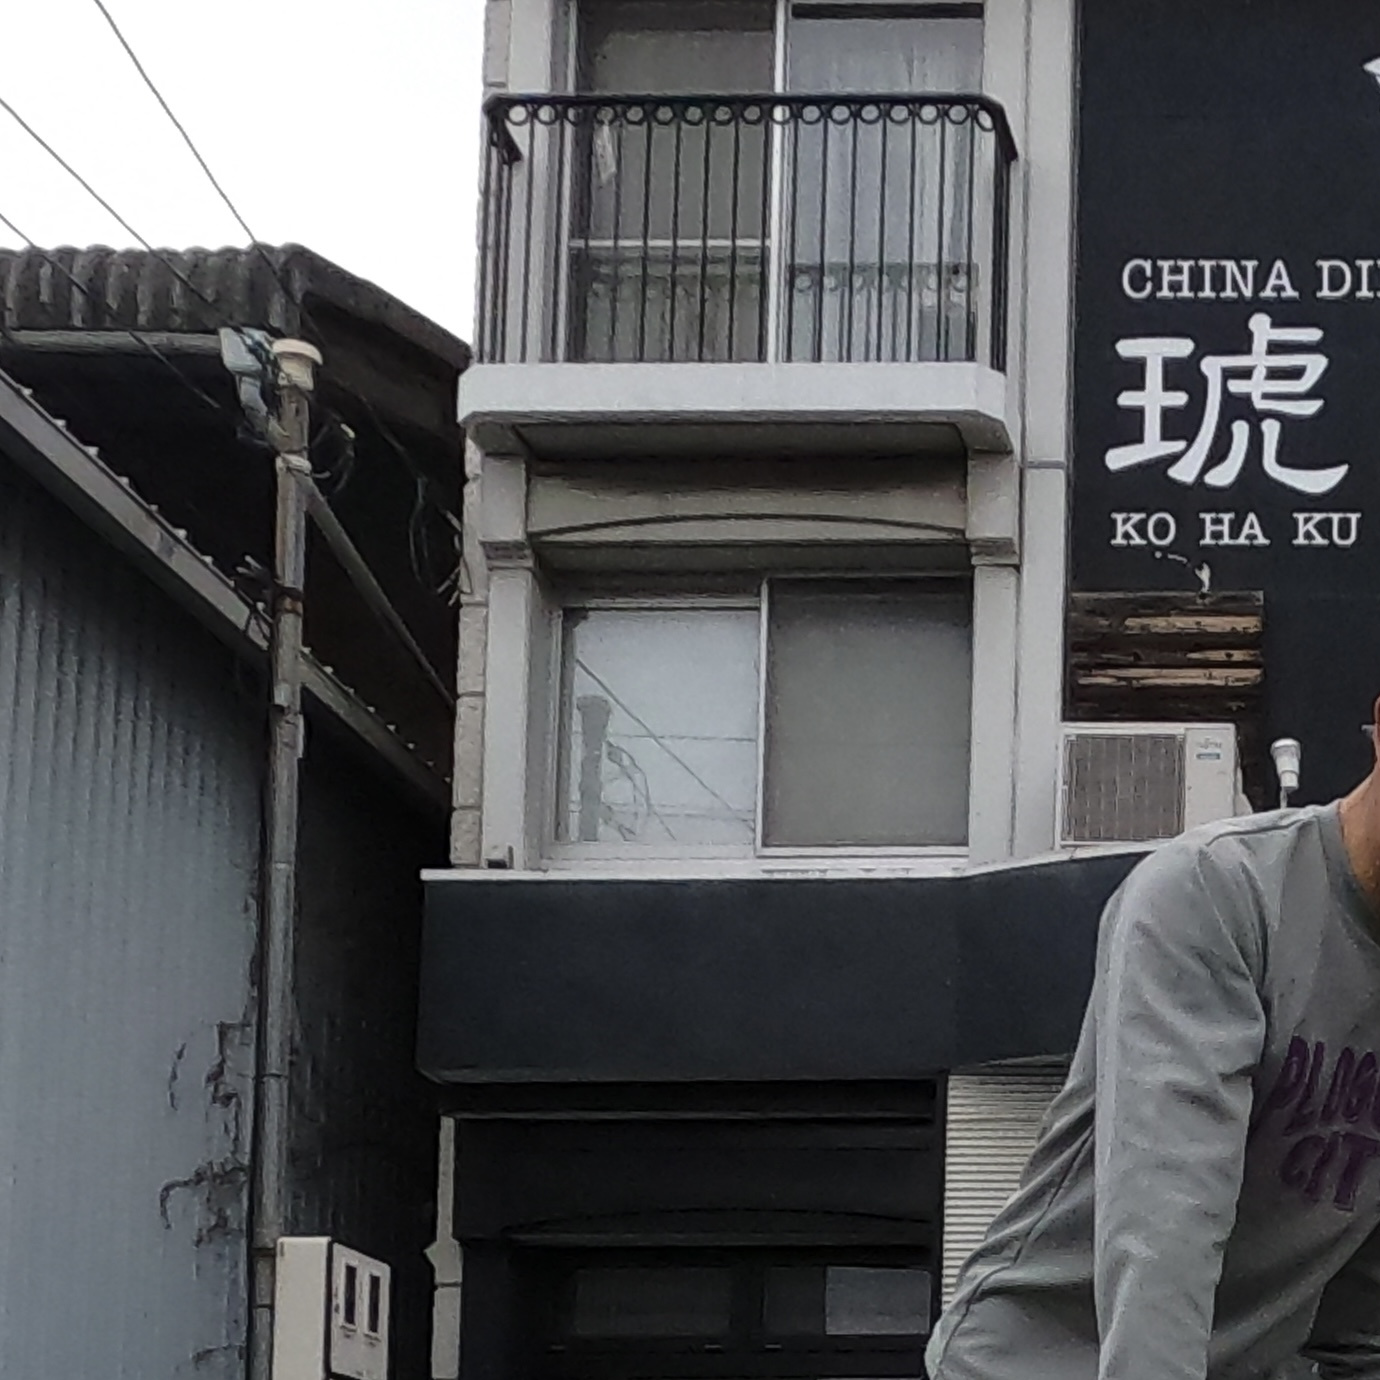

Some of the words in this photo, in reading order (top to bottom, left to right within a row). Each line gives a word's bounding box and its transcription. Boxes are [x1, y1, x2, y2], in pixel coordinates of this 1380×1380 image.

[1122, 258, 1300, 299] CHINA
[1110, 512, 1176, 546] KO
[1199, 512, 1271, 546] HA
[1292, 512, 1362, 546] KU
